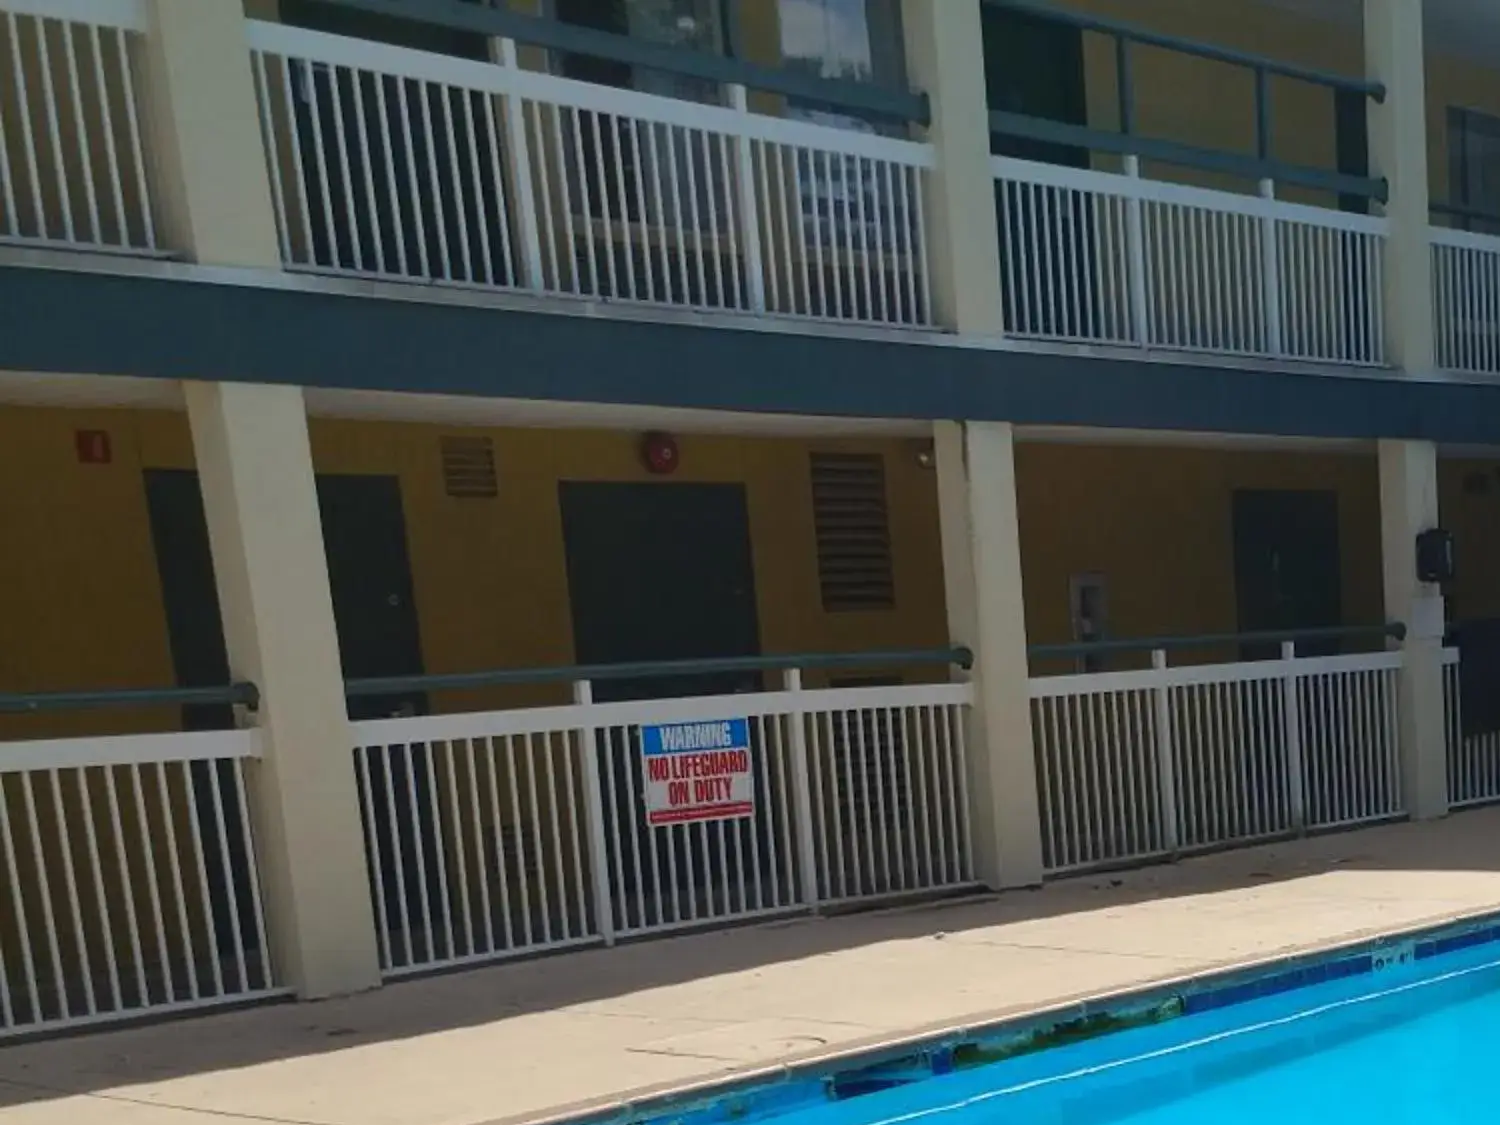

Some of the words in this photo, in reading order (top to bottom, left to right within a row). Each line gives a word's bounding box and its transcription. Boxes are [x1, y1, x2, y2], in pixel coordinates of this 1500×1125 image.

[661, 722, 732, 751] WARNING
[648, 757, 669, 781] NO
[671, 750, 748, 778] LIFEGUARD
[668, 782, 690, 805] ON
[694, 777, 733, 801] DUTY
